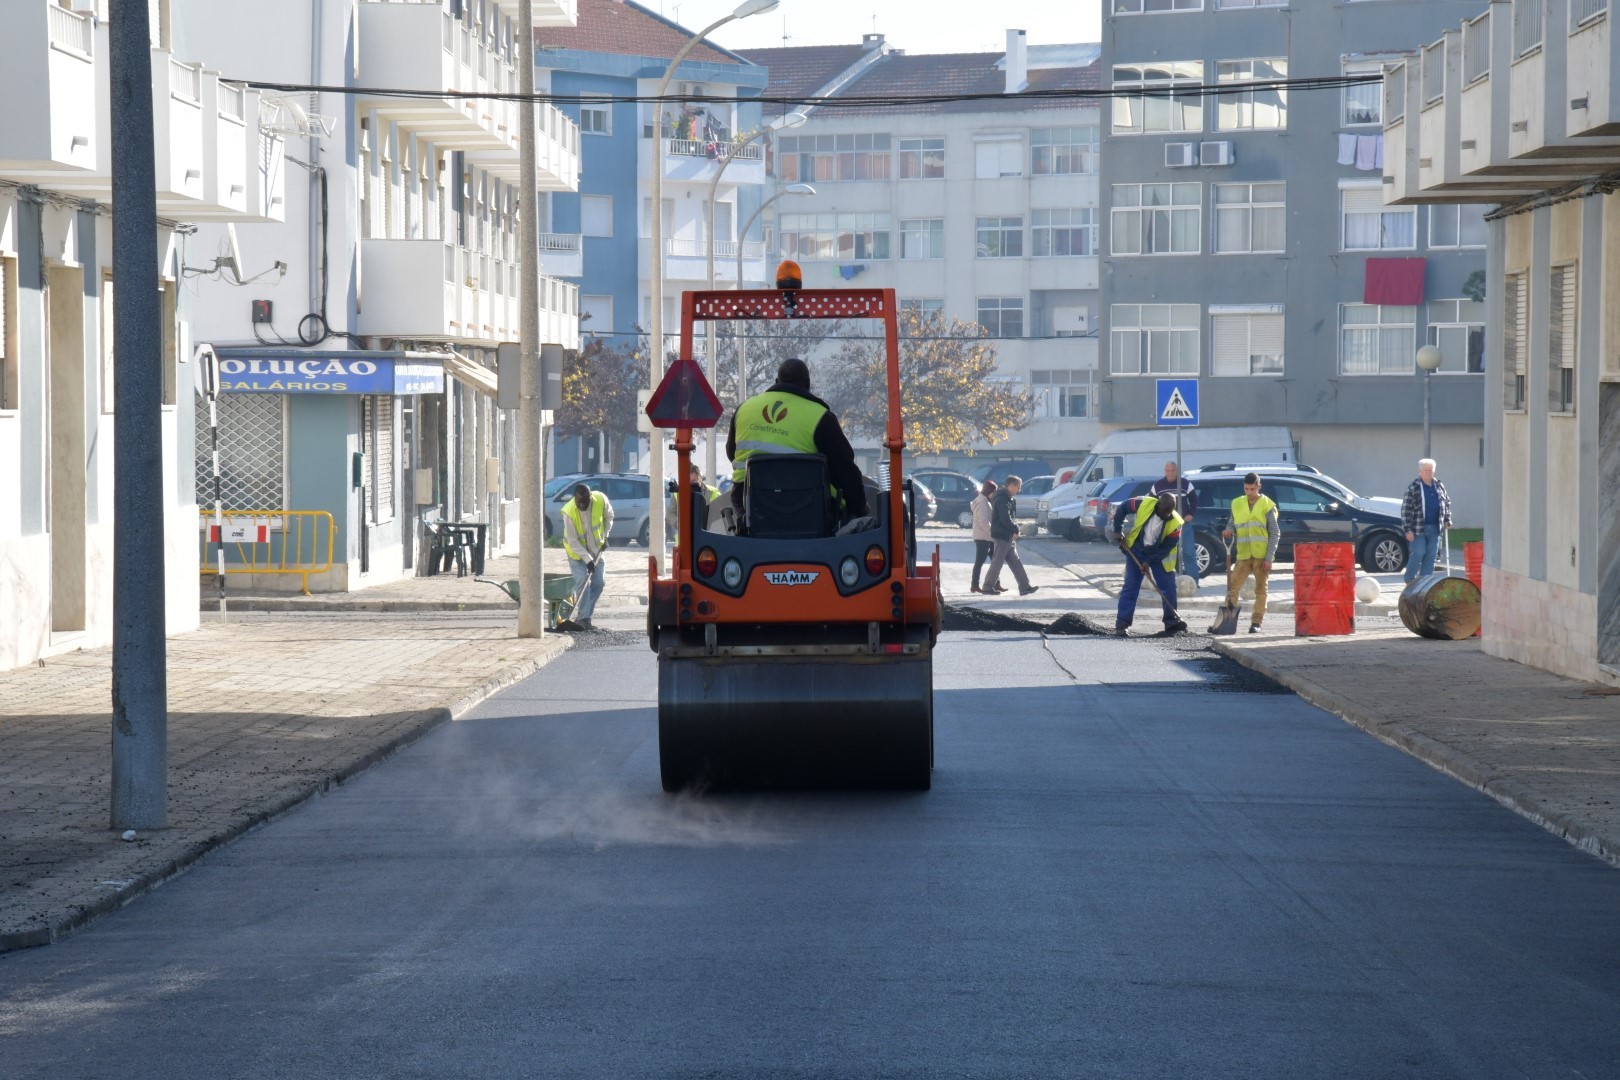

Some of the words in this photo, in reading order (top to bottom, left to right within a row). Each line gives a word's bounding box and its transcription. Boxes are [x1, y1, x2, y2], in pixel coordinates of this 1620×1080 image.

[219, 359, 377, 379] OLUÇÃO
[220, 380, 348, 391] SALÁRIOS
[772, 573, 810, 583] HAMM
